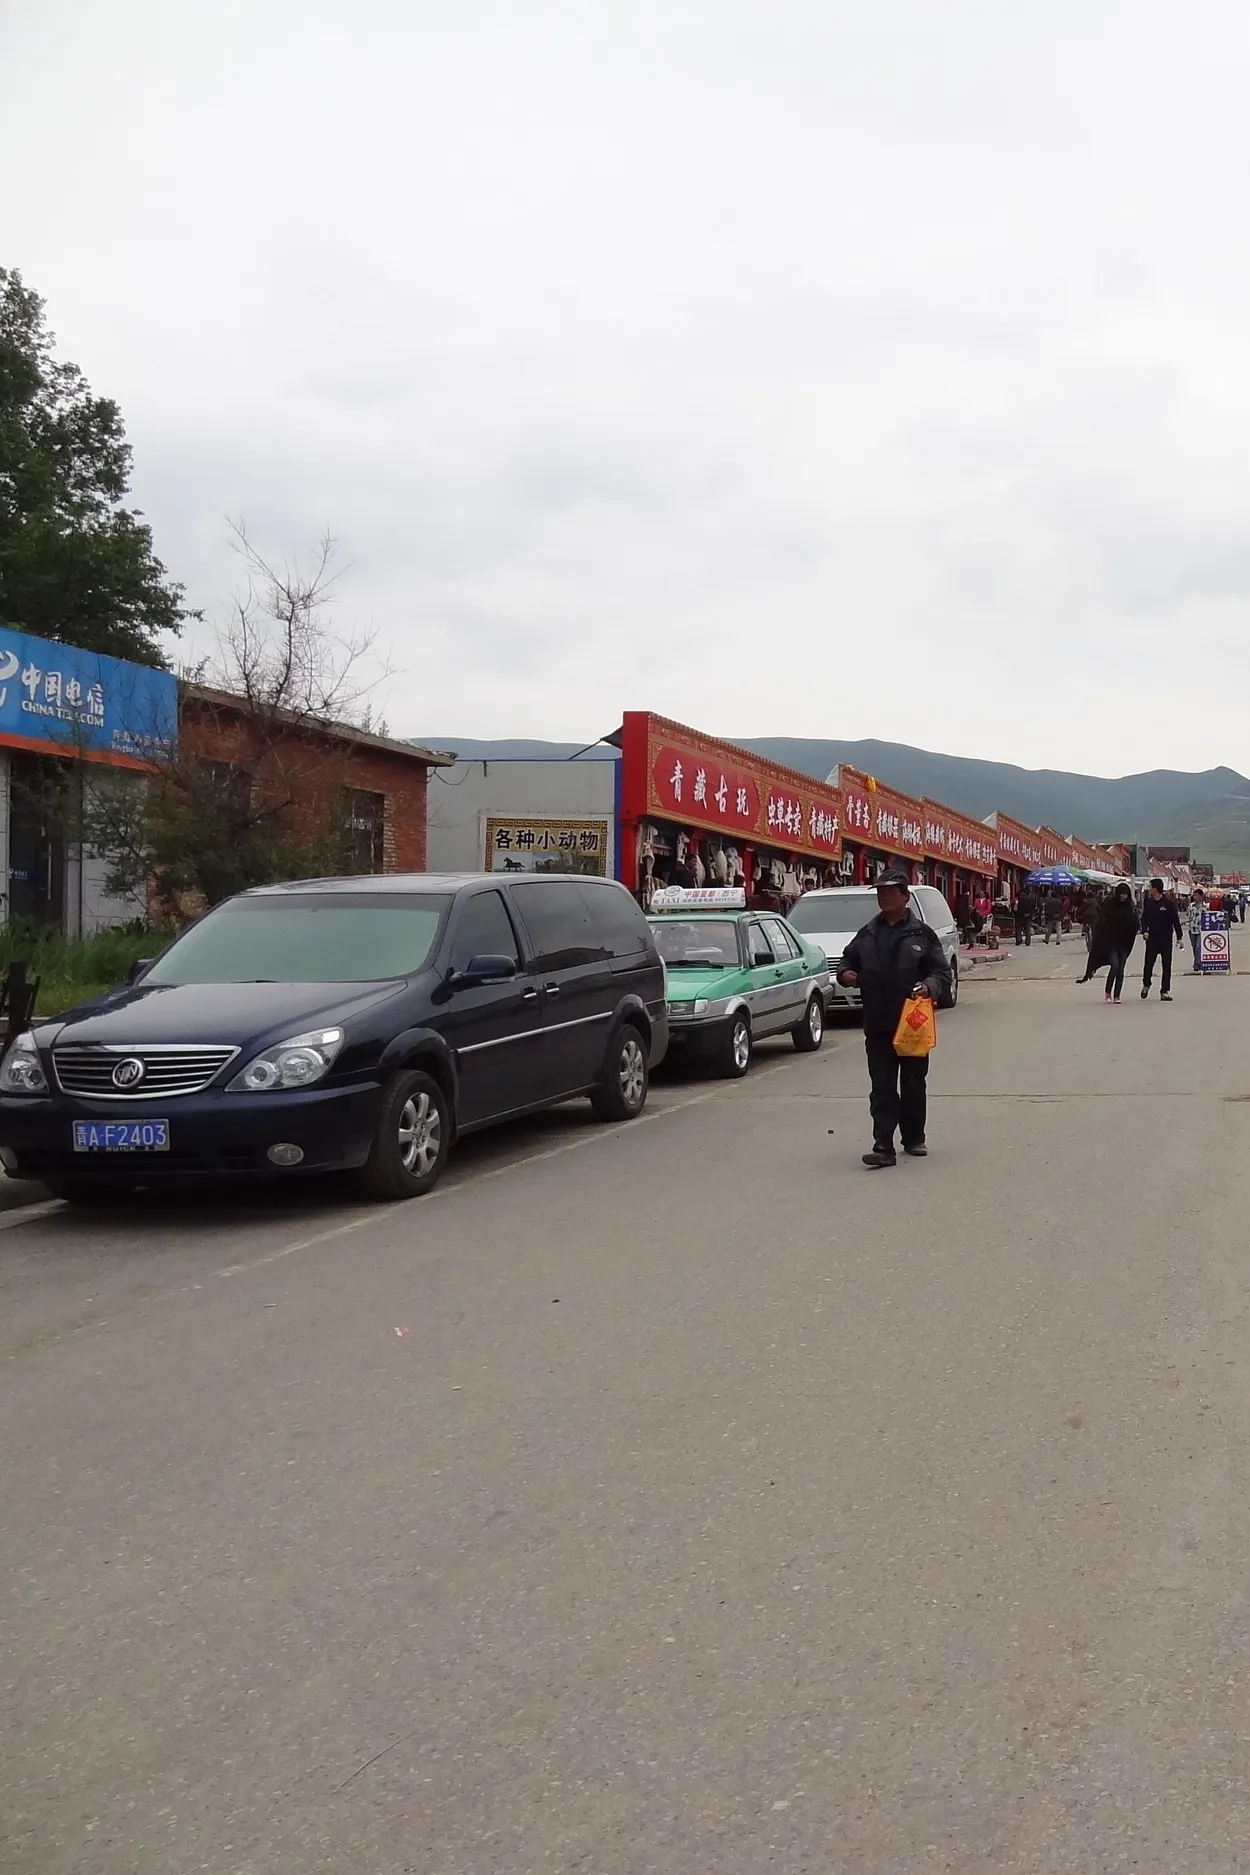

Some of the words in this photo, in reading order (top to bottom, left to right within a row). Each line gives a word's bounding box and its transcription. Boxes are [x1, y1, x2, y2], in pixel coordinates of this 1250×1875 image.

[21, 662, 104, 716] 中国电信
[669, 759, 750, 816] 青藏古玩
[494, 828, 599, 851] 各种小动物
[809, 806, 839, 845] 青藏特产
[661, 897, 681, 905] TAXI
